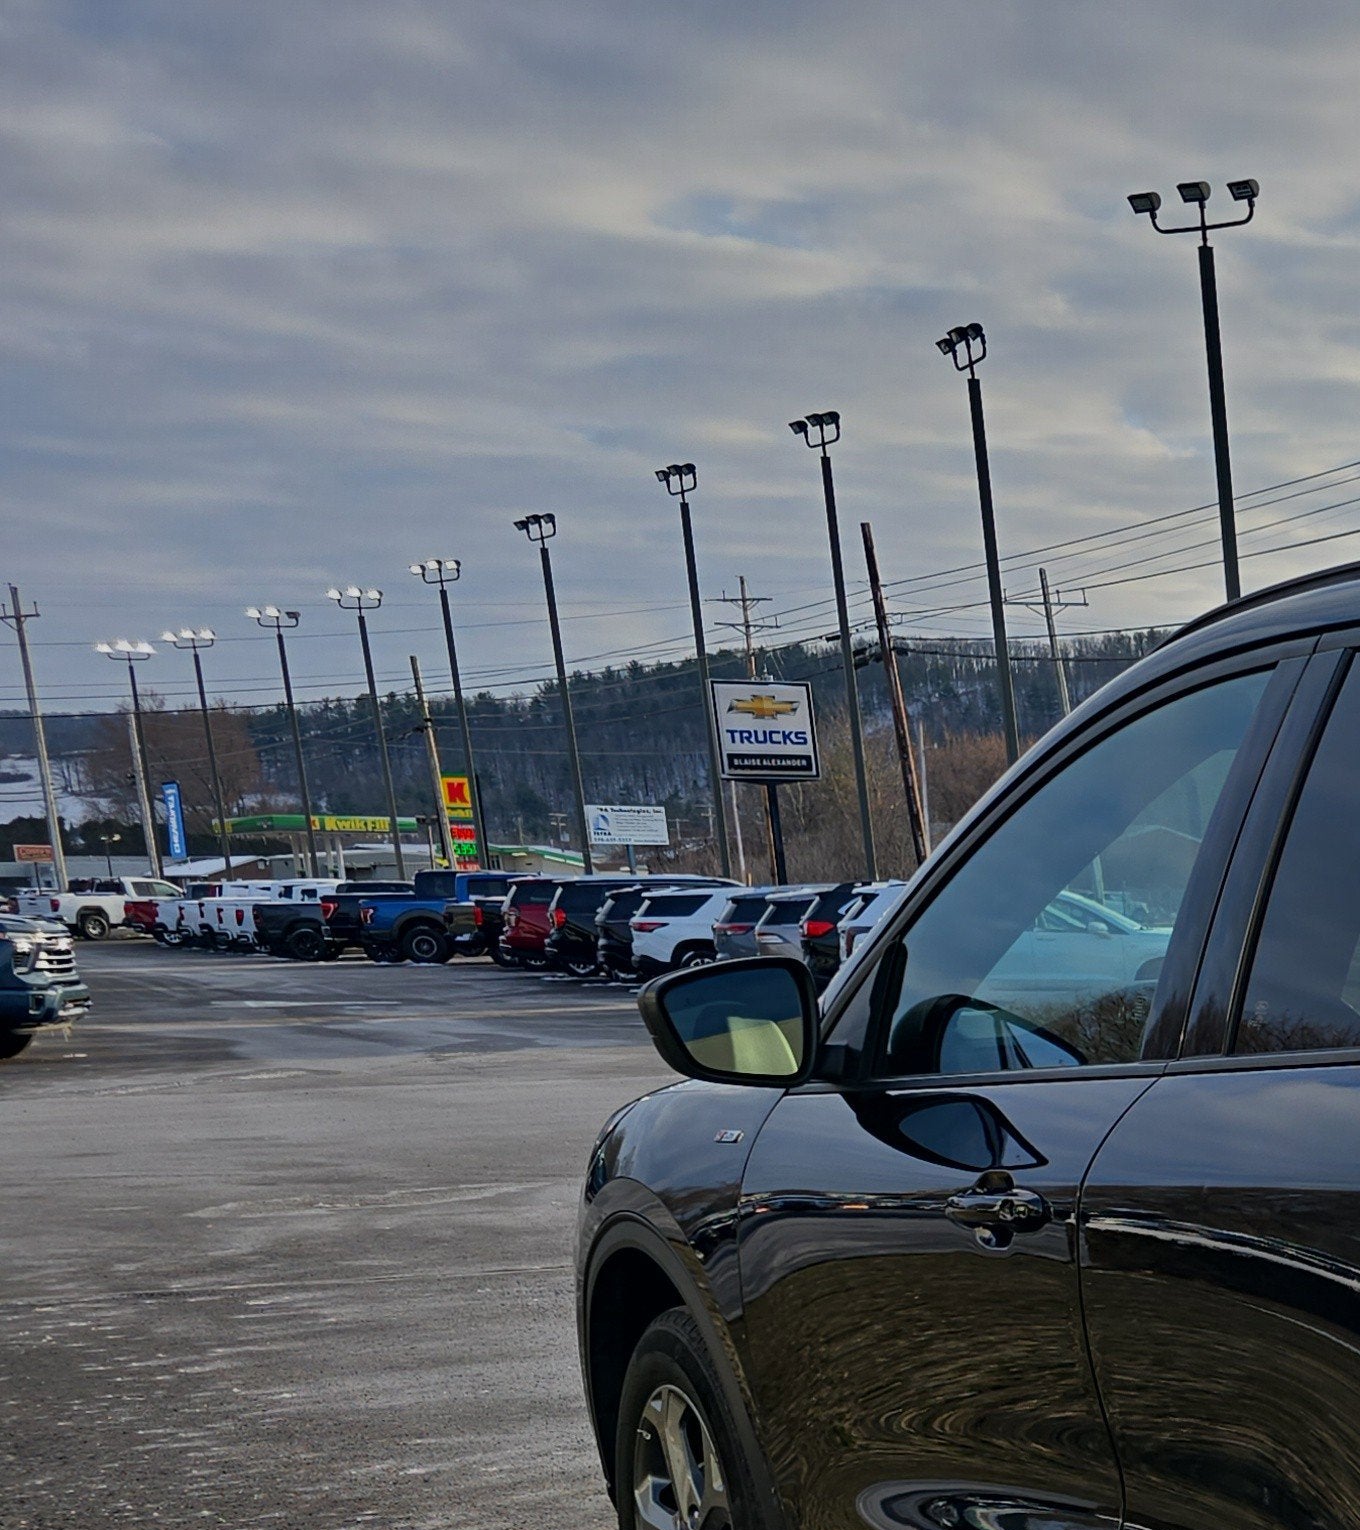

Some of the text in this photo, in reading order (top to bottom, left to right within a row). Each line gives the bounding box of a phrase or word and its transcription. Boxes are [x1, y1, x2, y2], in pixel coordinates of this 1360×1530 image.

[726, 729, 808, 745] TRUCKS
[733, 758, 808, 767] BLAISE ALEXANDER
[447, 782, 469, 804] K
